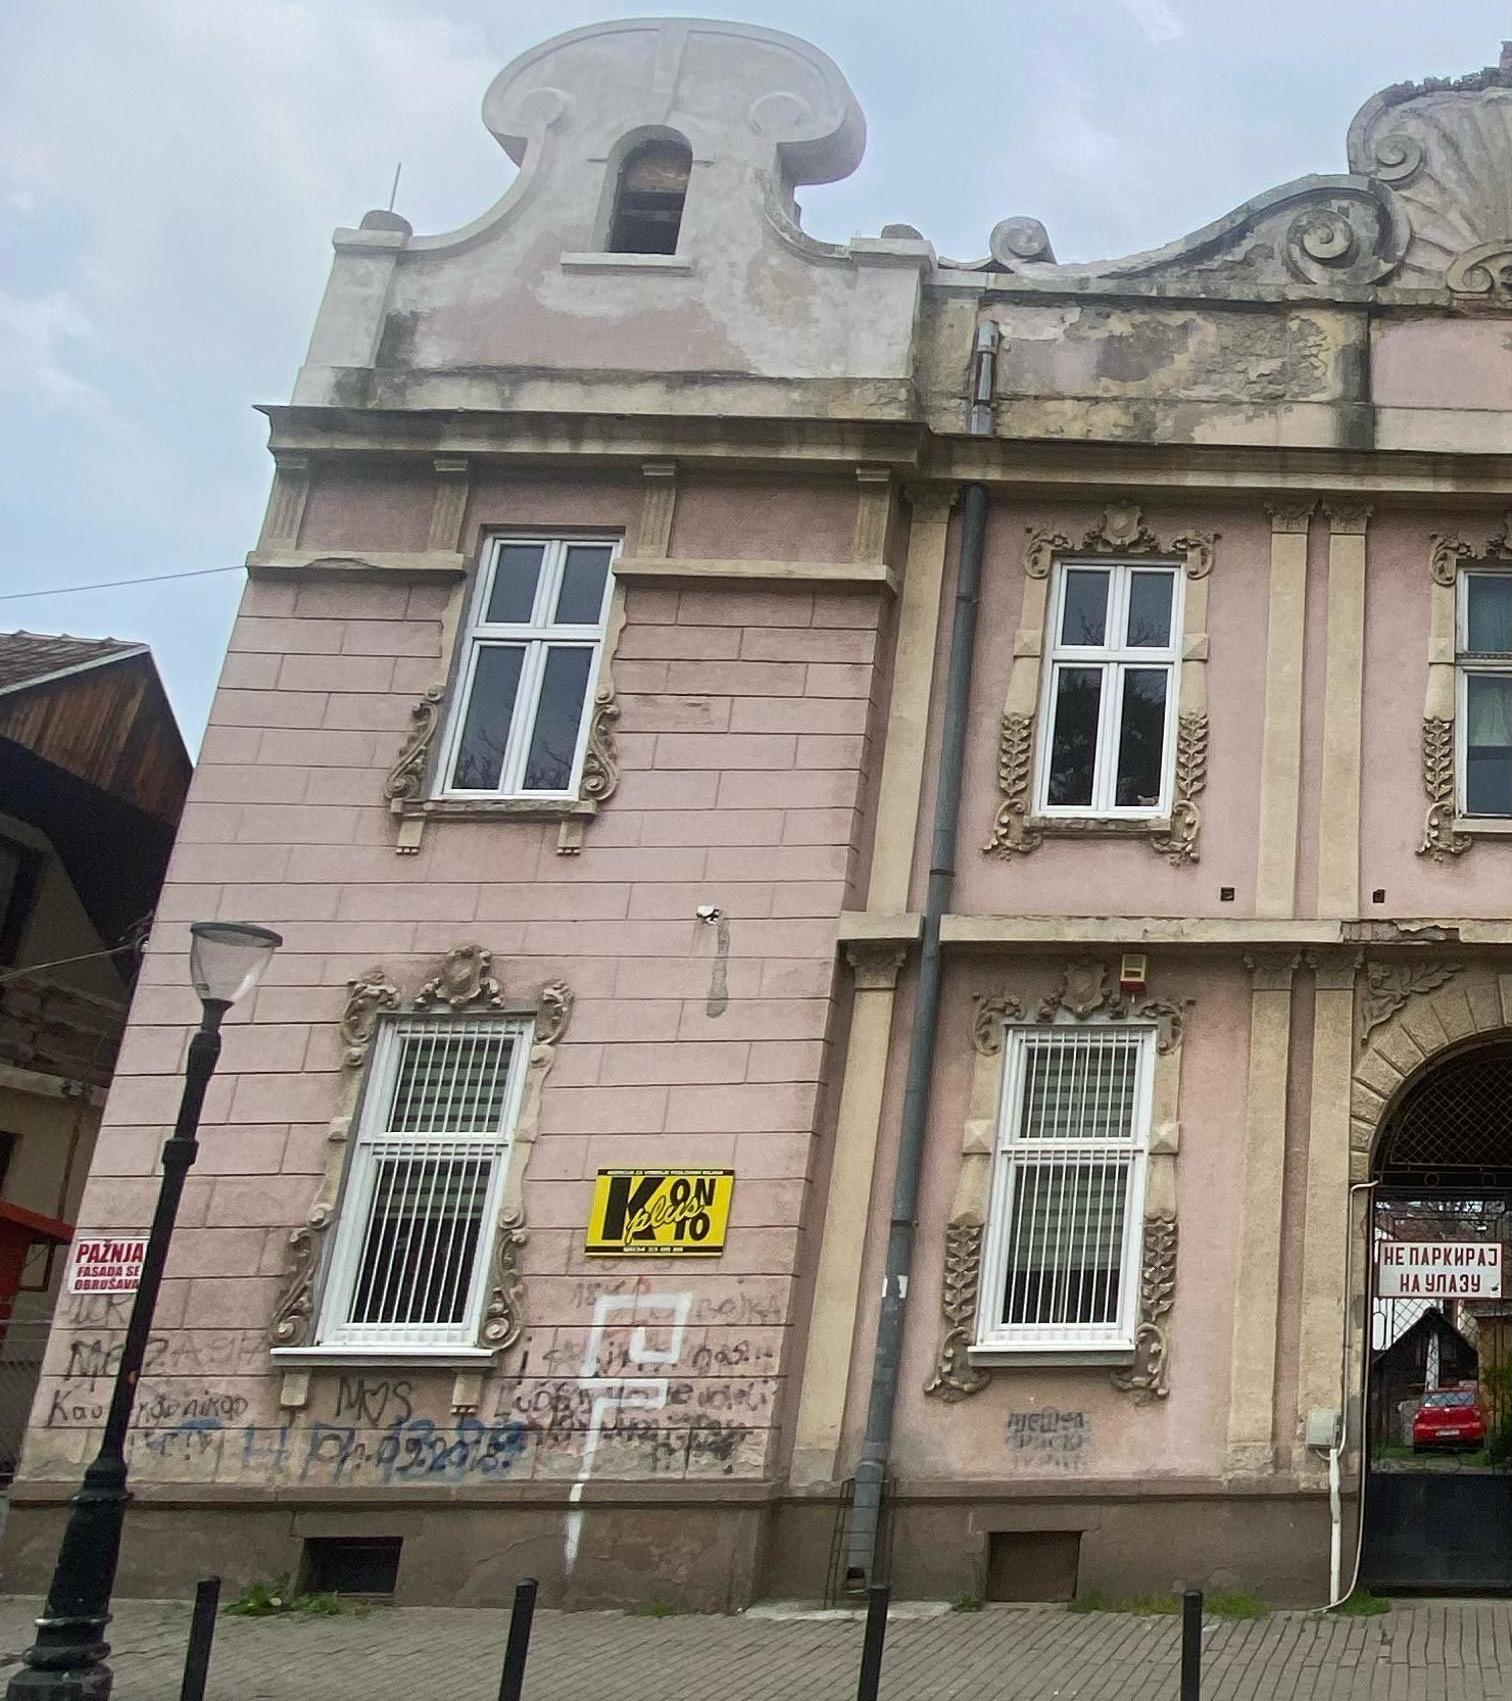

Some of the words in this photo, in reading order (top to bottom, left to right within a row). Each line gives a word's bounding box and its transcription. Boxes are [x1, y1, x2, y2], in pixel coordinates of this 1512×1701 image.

[625, 1195, 704, 1246] plus
[75, 1239, 144, 1263] PAŽNJA
[1384, 1247, 1405, 1265] НЕ
[1409, 1247, 1498, 1266] ПАРКИРАЈ
[77, 1266, 122, 1277] FASADA
[126, 1265, 140, 1277] SE
[1400, 1274, 1420, 1292] НА
[1425, 1274, 1480, 1292] УЛАЗУ
